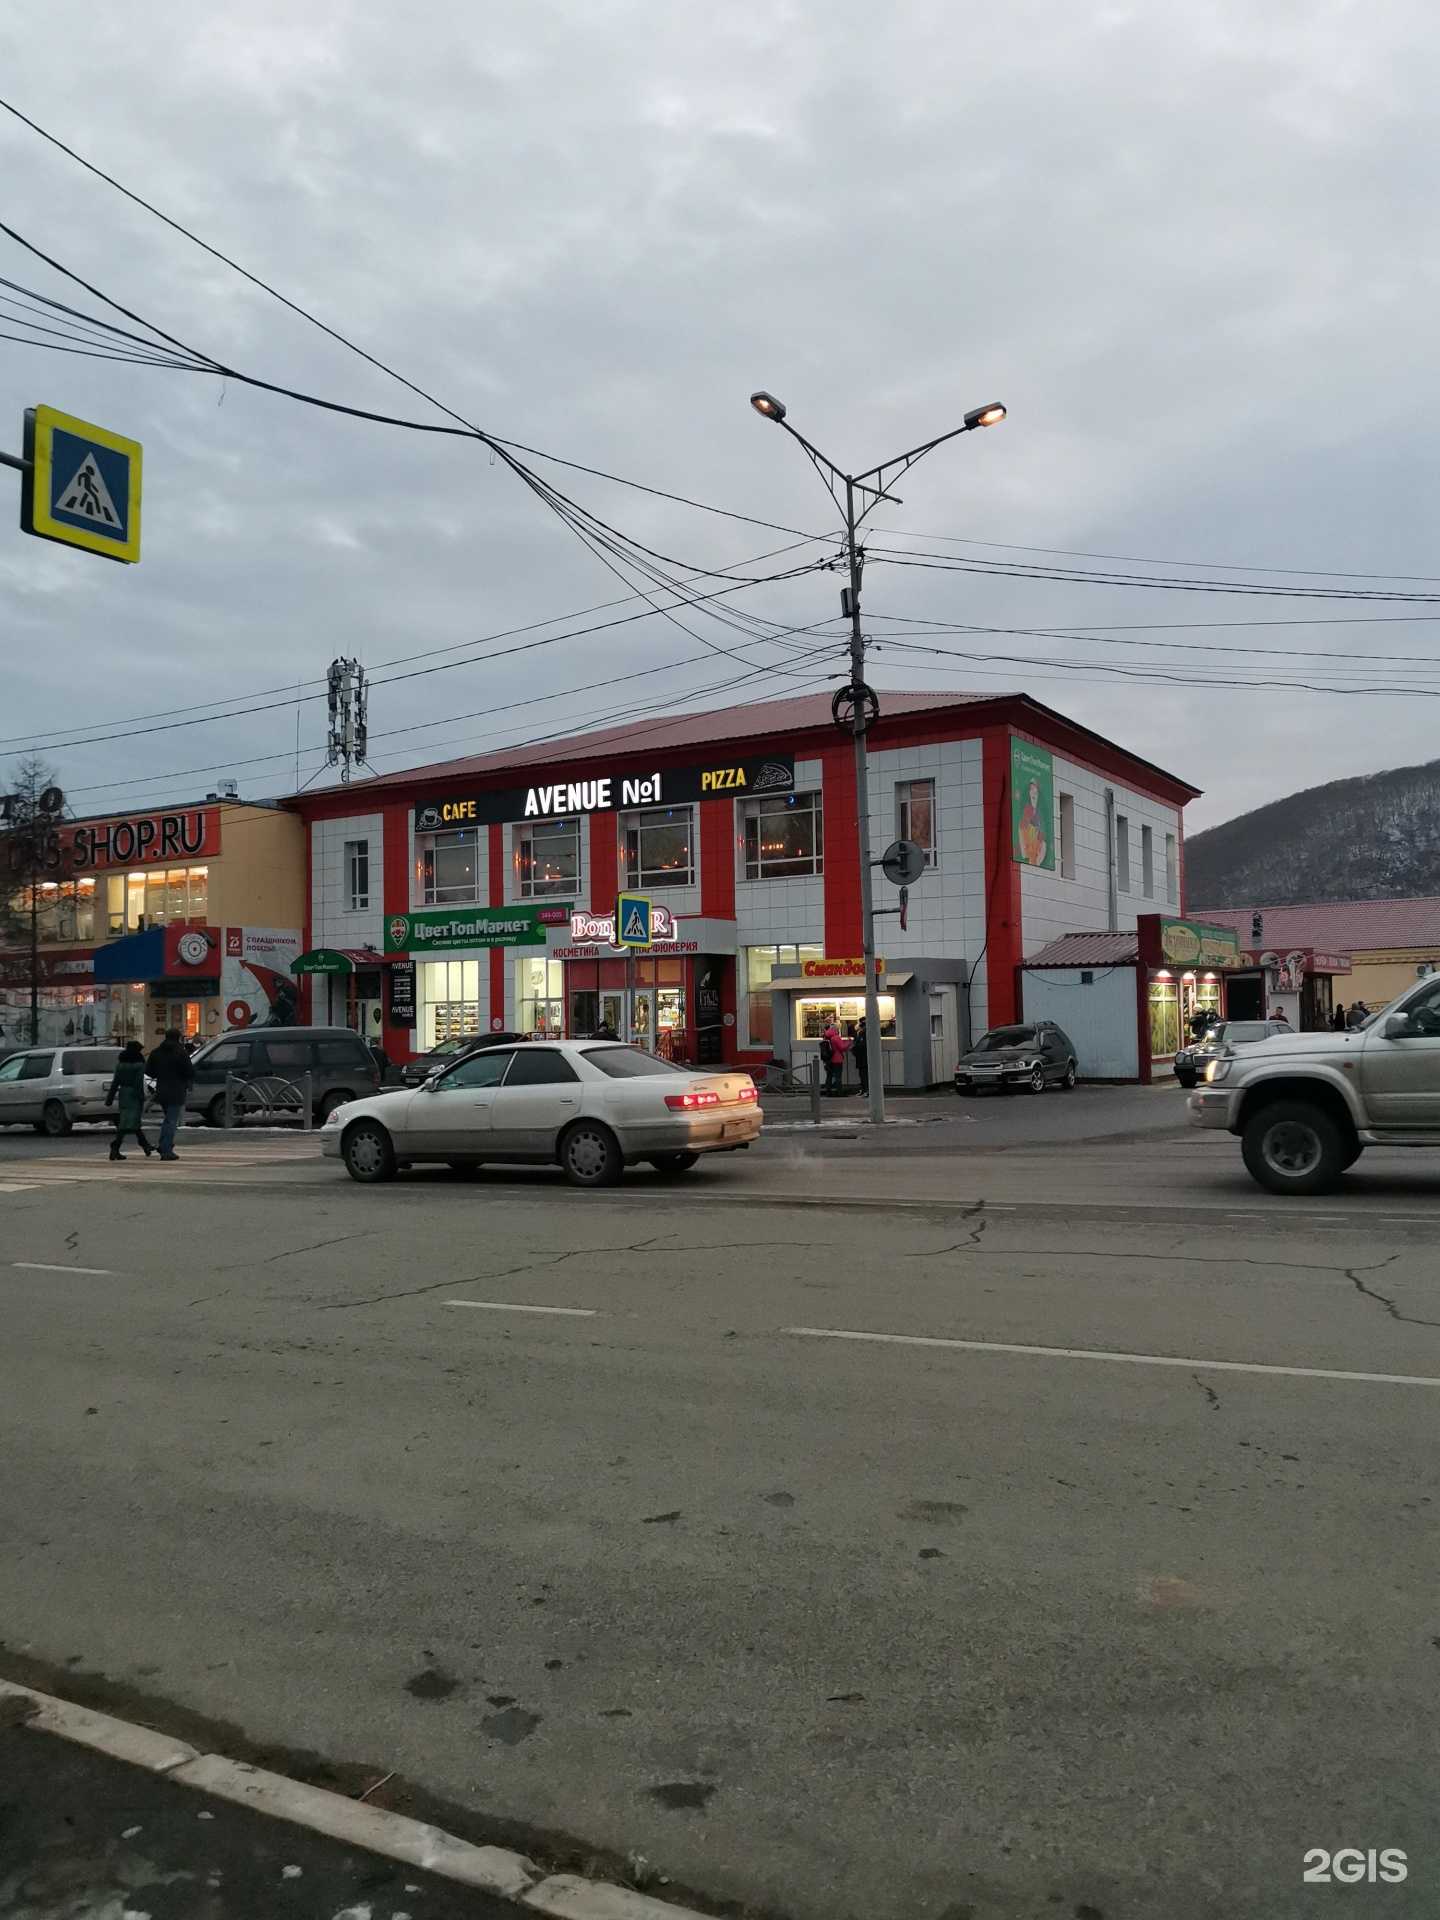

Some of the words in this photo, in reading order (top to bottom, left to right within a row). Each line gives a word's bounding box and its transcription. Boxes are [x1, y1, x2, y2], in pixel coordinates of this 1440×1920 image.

[702, 768, 746, 791] PIZZA
[524, 778, 611, 817] AVENUE
[443, 801, 477, 822] CAFE
[73, 812, 206, 868] SHOP.RU
[414, 919, 531, 940] ЦветТопМаркет
[553, 946, 599, 958] КОСМЕТИКА
[391, 962, 414, 970] AVENUE
[391, 1006, 415, 1014] AVENUE
